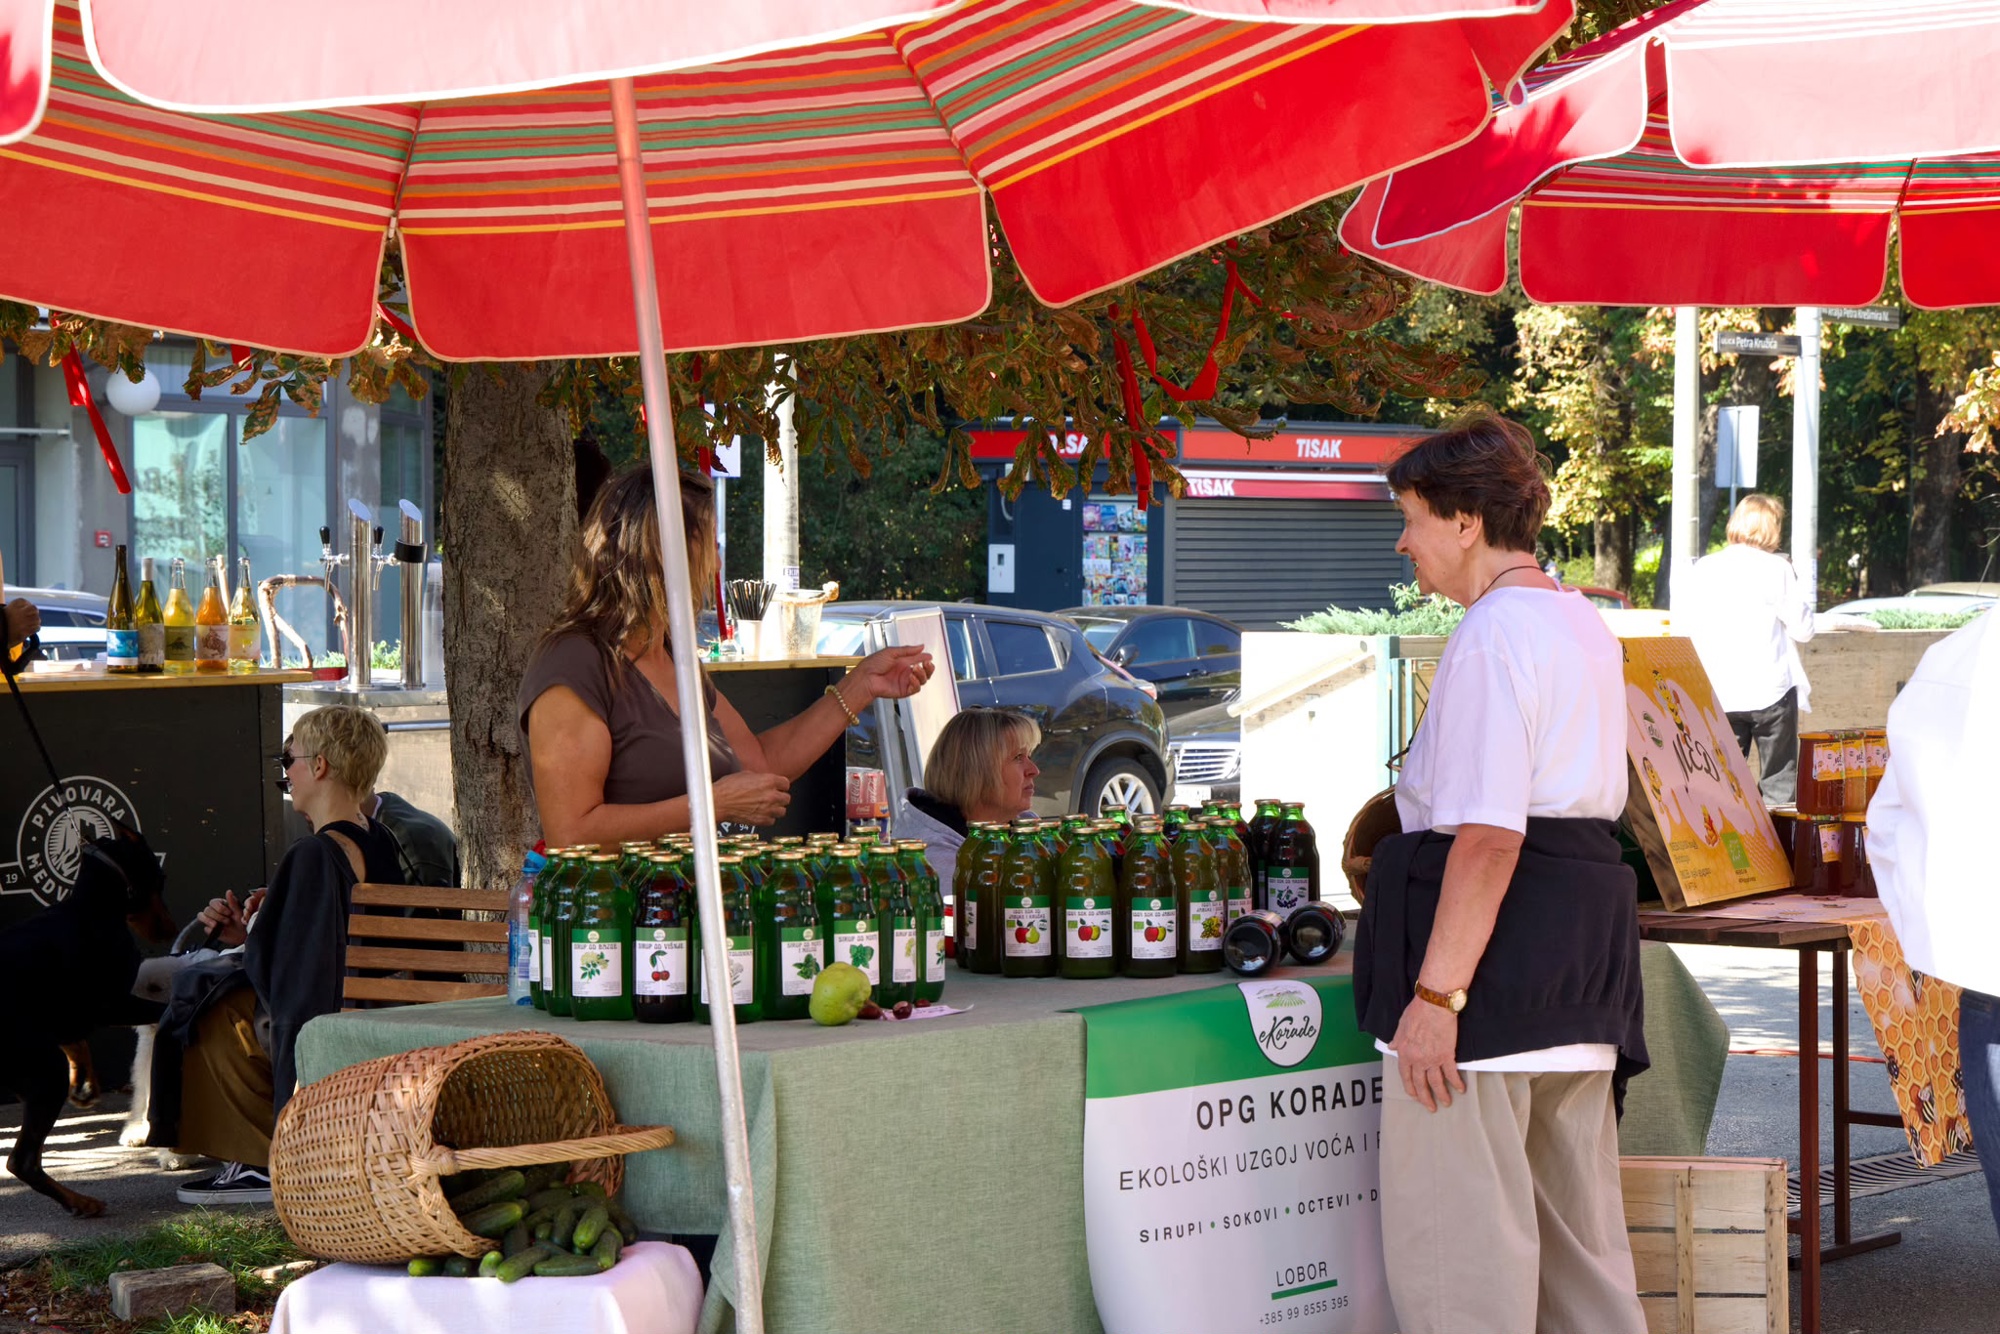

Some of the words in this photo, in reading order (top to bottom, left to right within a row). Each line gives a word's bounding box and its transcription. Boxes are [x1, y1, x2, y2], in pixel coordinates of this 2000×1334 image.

[1736, 336, 1753, 349] Petra
[1754, 336, 1778, 350] Kružića
[1296, 438, 1342, 459] TISAK
[1189, 478, 1235, 496] TISAK
[32, 785, 126, 828] PIVOVARA
[5, 873, 18, 884] 19
[27, 852, 73, 902] MEDV
[1258, 1015, 1317, 1050] eKorade
[1196, 1094, 1255, 1130] OPG
[1270, 1076, 1383, 1119] KORADE
[1119, 1154, 1228, 1191] EKOLOŠKI
[1236, 1144, 1297, 1173] UZGOJ
[1304, 1132, 1355, 1161] VOĆA
[1139, 1221, 1202, 1243] SIRUPI
[1223, 1207, 1278, 1230] SOKOVI
[1298, 1193, 1350, 1216] OCTEVI
[1276, 1261, 1328, 1287] LOBOR
[1259, 1310, 1283, 1325] +385
[1287, 1306, 1300, 1320] 99
[1303, 1300, 1328, 1316] 8555
[1331, 1295, 1349, 1310] 395
